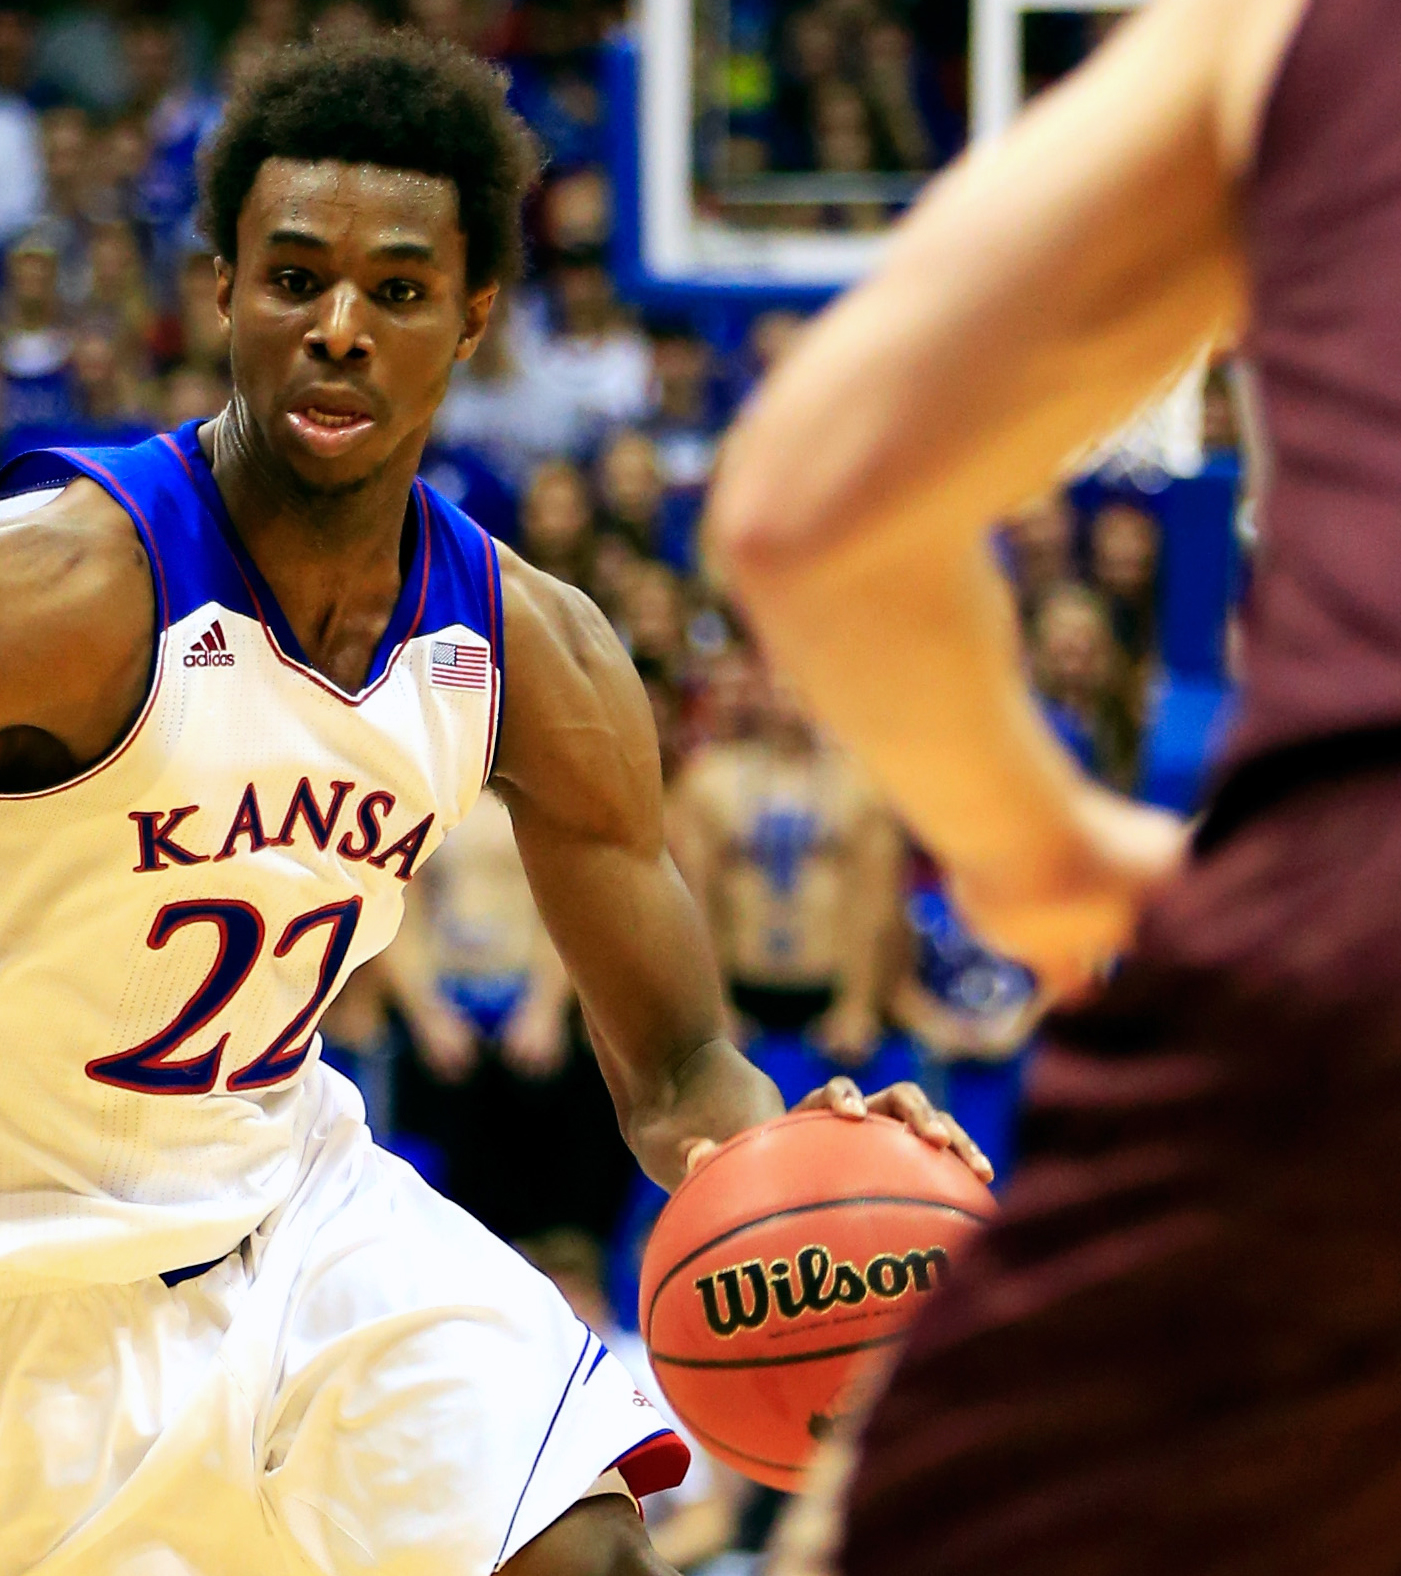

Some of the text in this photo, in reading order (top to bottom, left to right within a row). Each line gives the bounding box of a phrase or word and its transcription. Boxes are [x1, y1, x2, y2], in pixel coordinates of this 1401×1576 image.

[183, 650, 235, 667] adidas
[85, 894, 363, 1095] 22
[694, 1244, 948, 1339] Wilson
